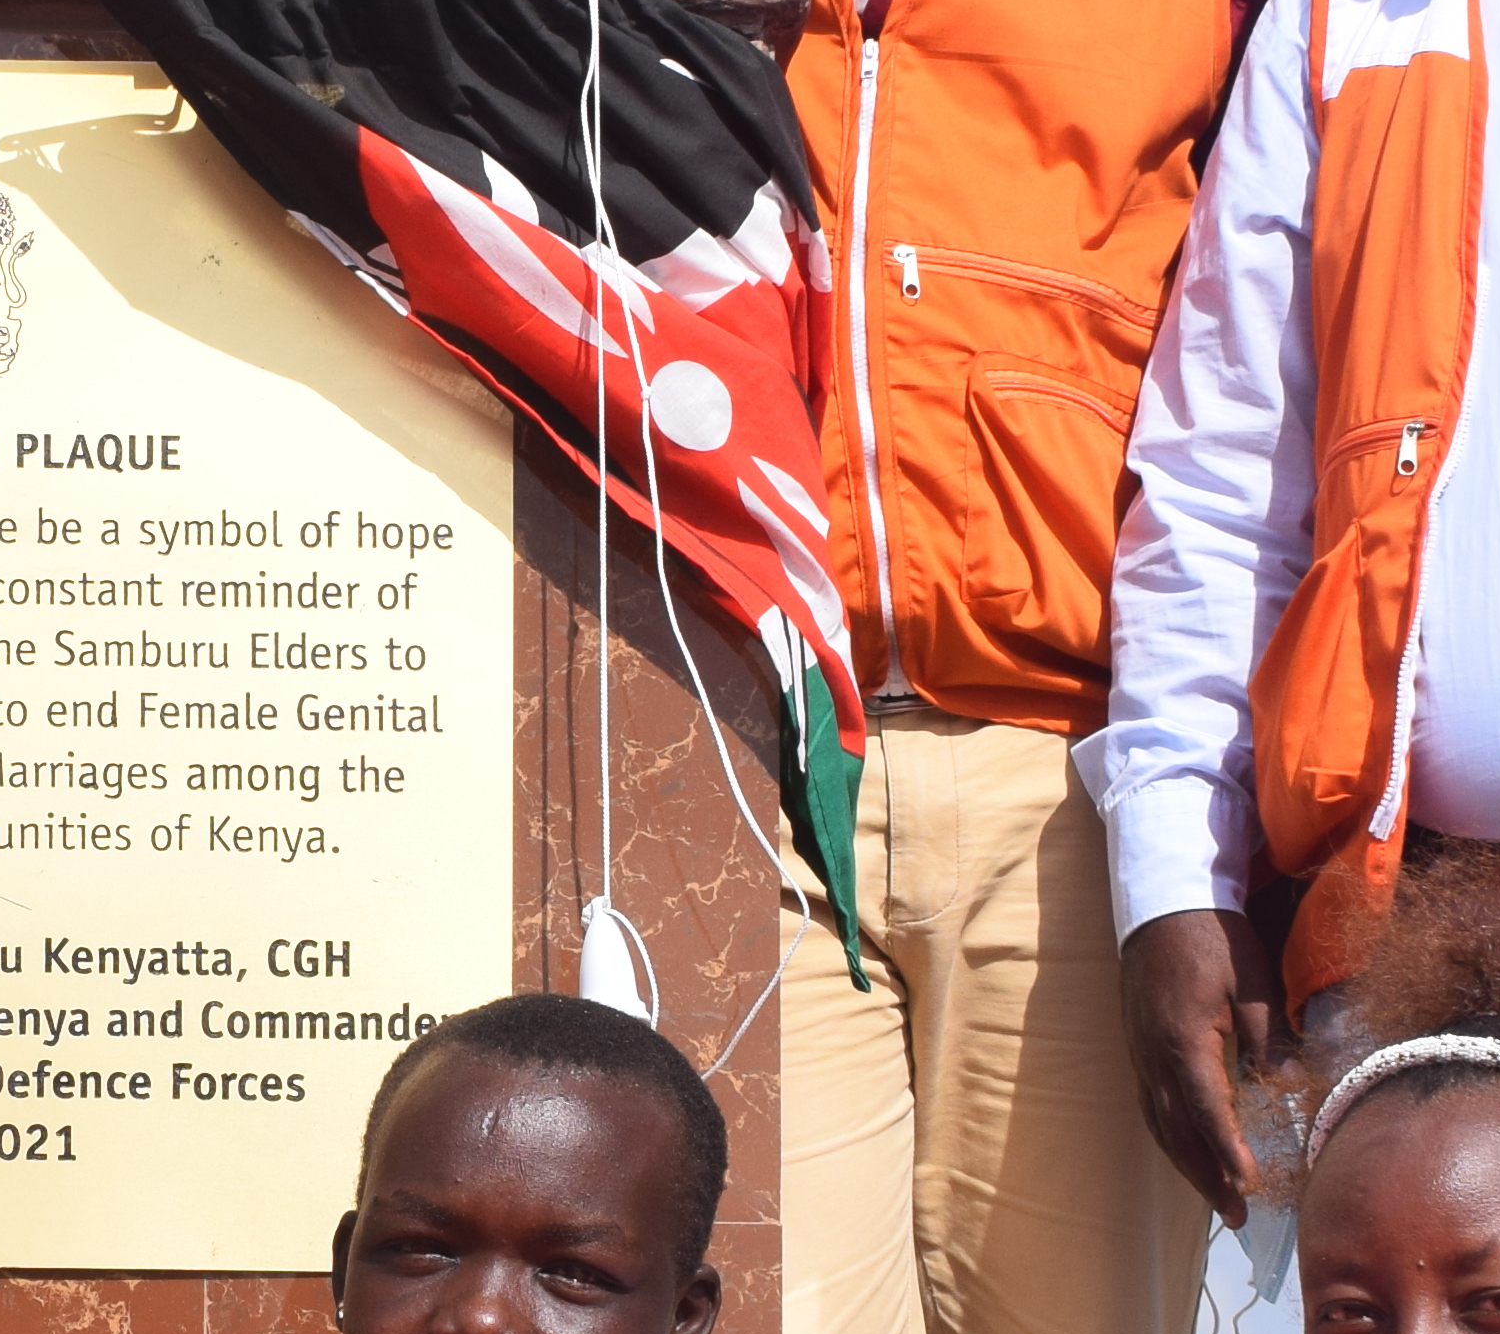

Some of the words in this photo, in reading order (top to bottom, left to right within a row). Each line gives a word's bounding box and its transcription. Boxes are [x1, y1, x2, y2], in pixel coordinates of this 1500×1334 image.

[16, 433, 181, 474] PLAQUE
[36, 506, 82, 545] be
[100, 519, 120, 546] a
[139, 509, 283, 556] symbol
[299, 510, 341, 549] of
[357, 510, 454, 560] hope
[181, 570, 361, 610] reminder
[377, 572, 419, 611] of
[53, 629, 230, 669] Samburu
[251, 631, 368, 671] Elders
[384, 637, 426, 672] to
[46, 690, 118, 729] end
[140, 691, 278, 731] Female
[296, 693, 444, 733] Genital
[186, 763, 321, 803] among
[338, 754, 405, 794] the
[150, 813, 192, 852] of
[209, 815, 340, 864] Kenya.
[44, 937, 248, 986] Kenyatta,
[267, 938, 351, 978] CGH
[106, 999, 183, 1039] and
[201, 1000, 449, 1043] Commande
[171, 1062, 306, 1103] Forces
